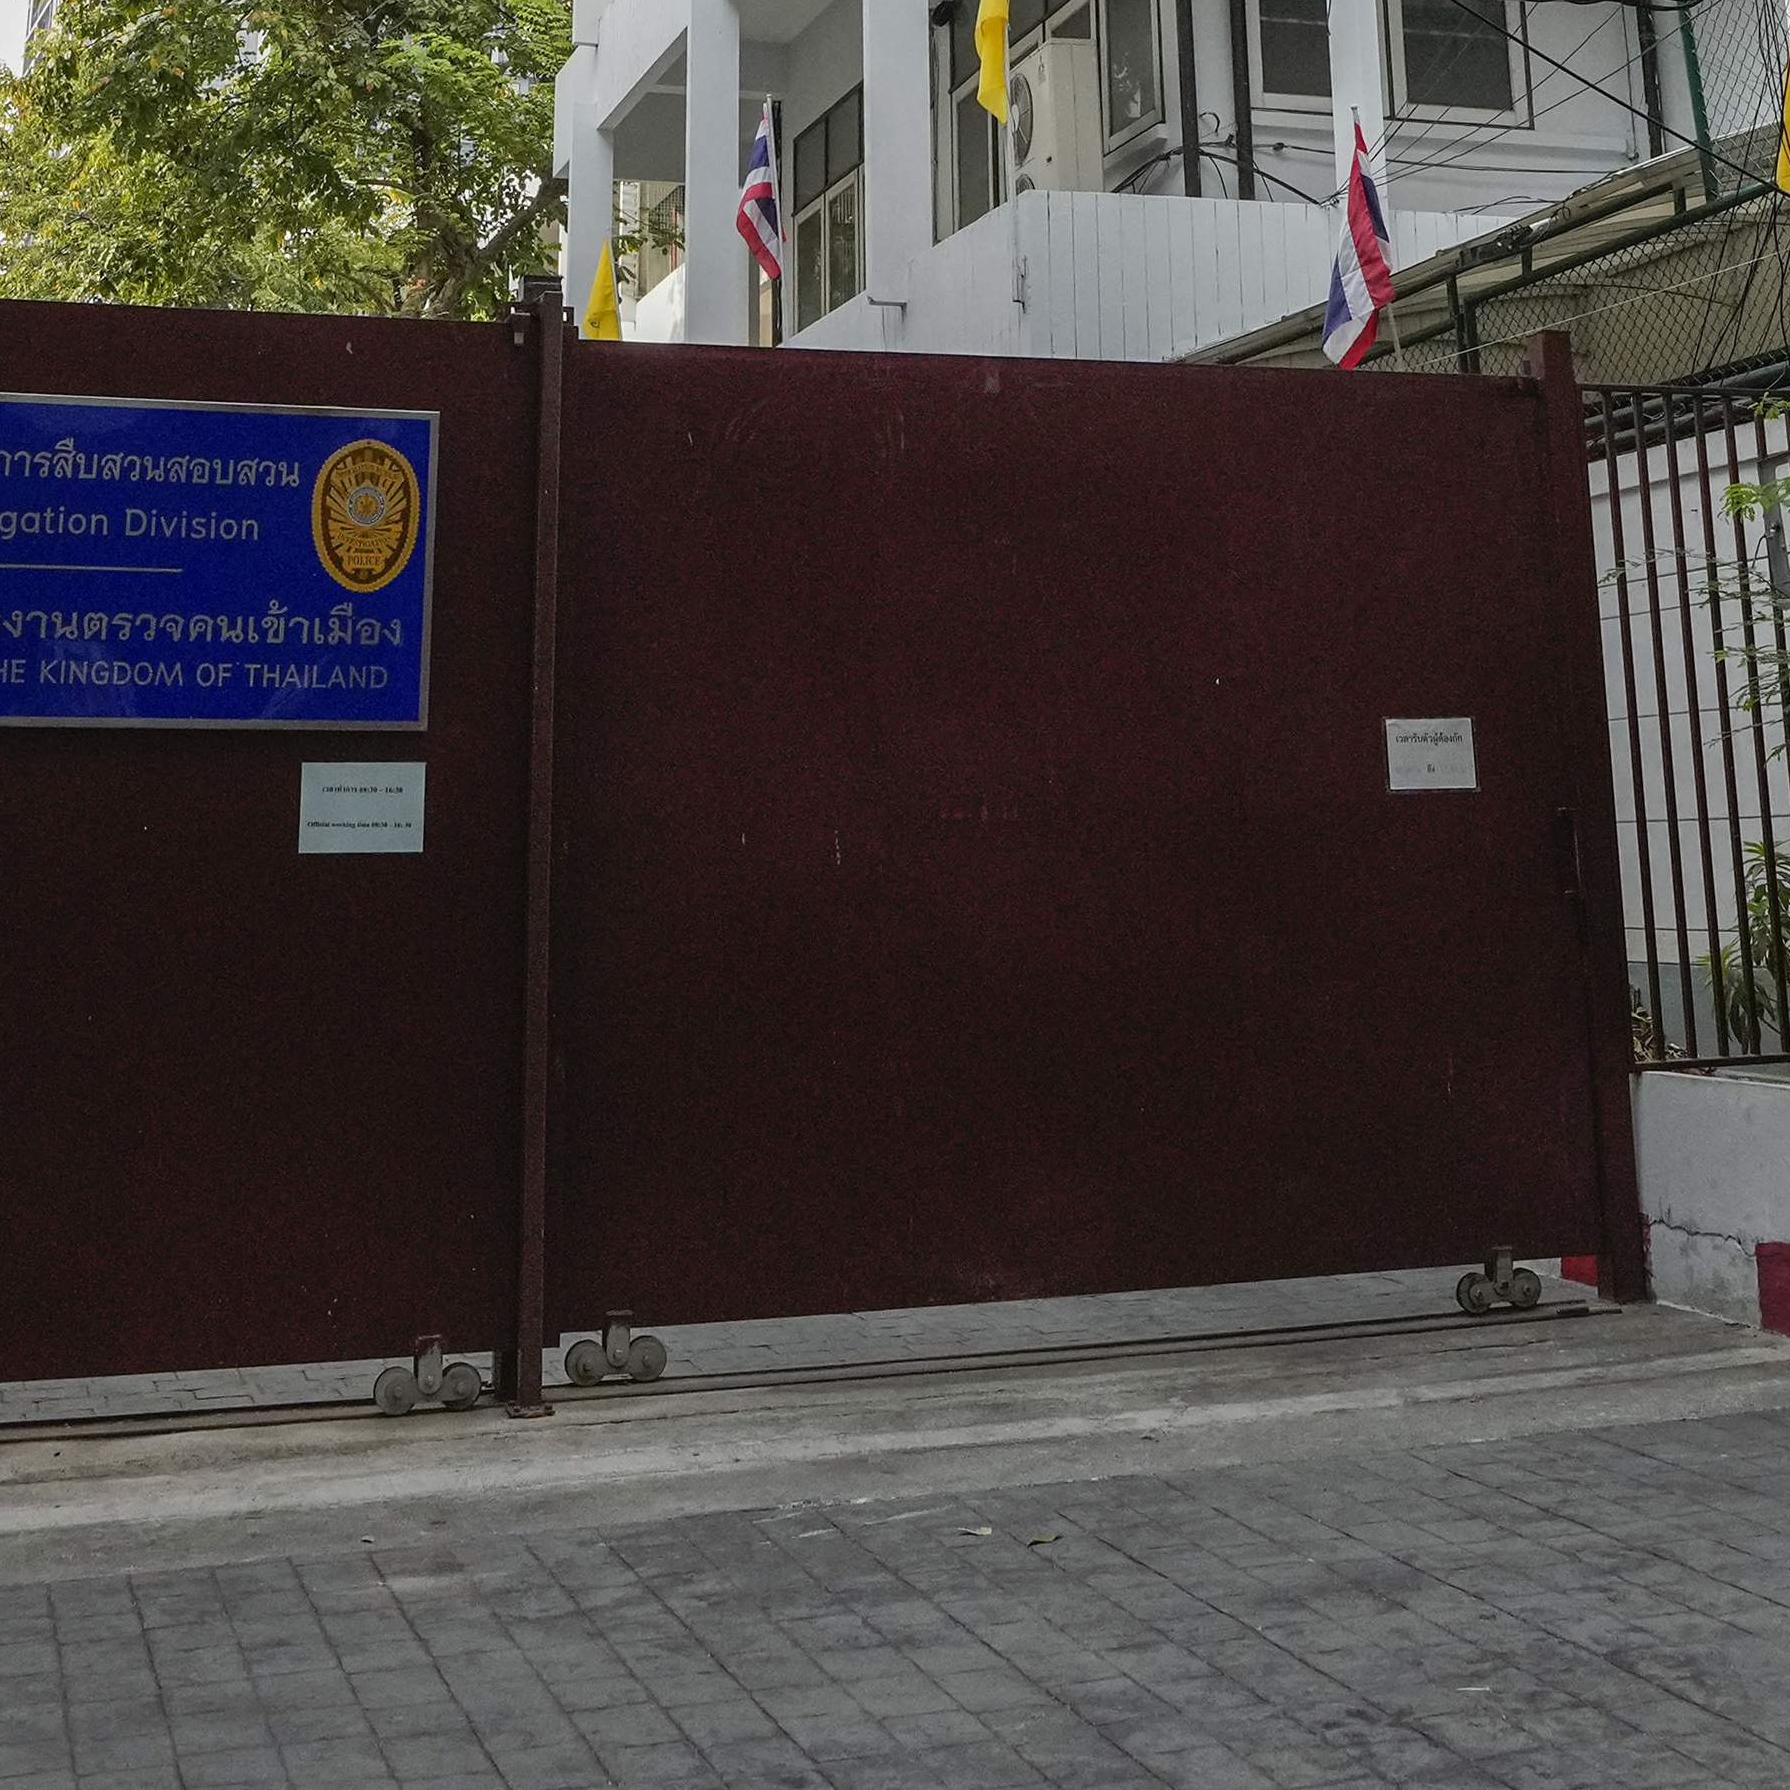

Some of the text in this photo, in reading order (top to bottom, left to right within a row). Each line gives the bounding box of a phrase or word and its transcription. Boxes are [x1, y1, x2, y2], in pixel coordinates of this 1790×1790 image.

[124, 507, 260, 541] Division
[39, 659, 184, 687] KINGDOM
[196, 662, 233, 687] OF
[244, 663, 389, 690] THAILAND
[307, 820, 330, 828] Official
